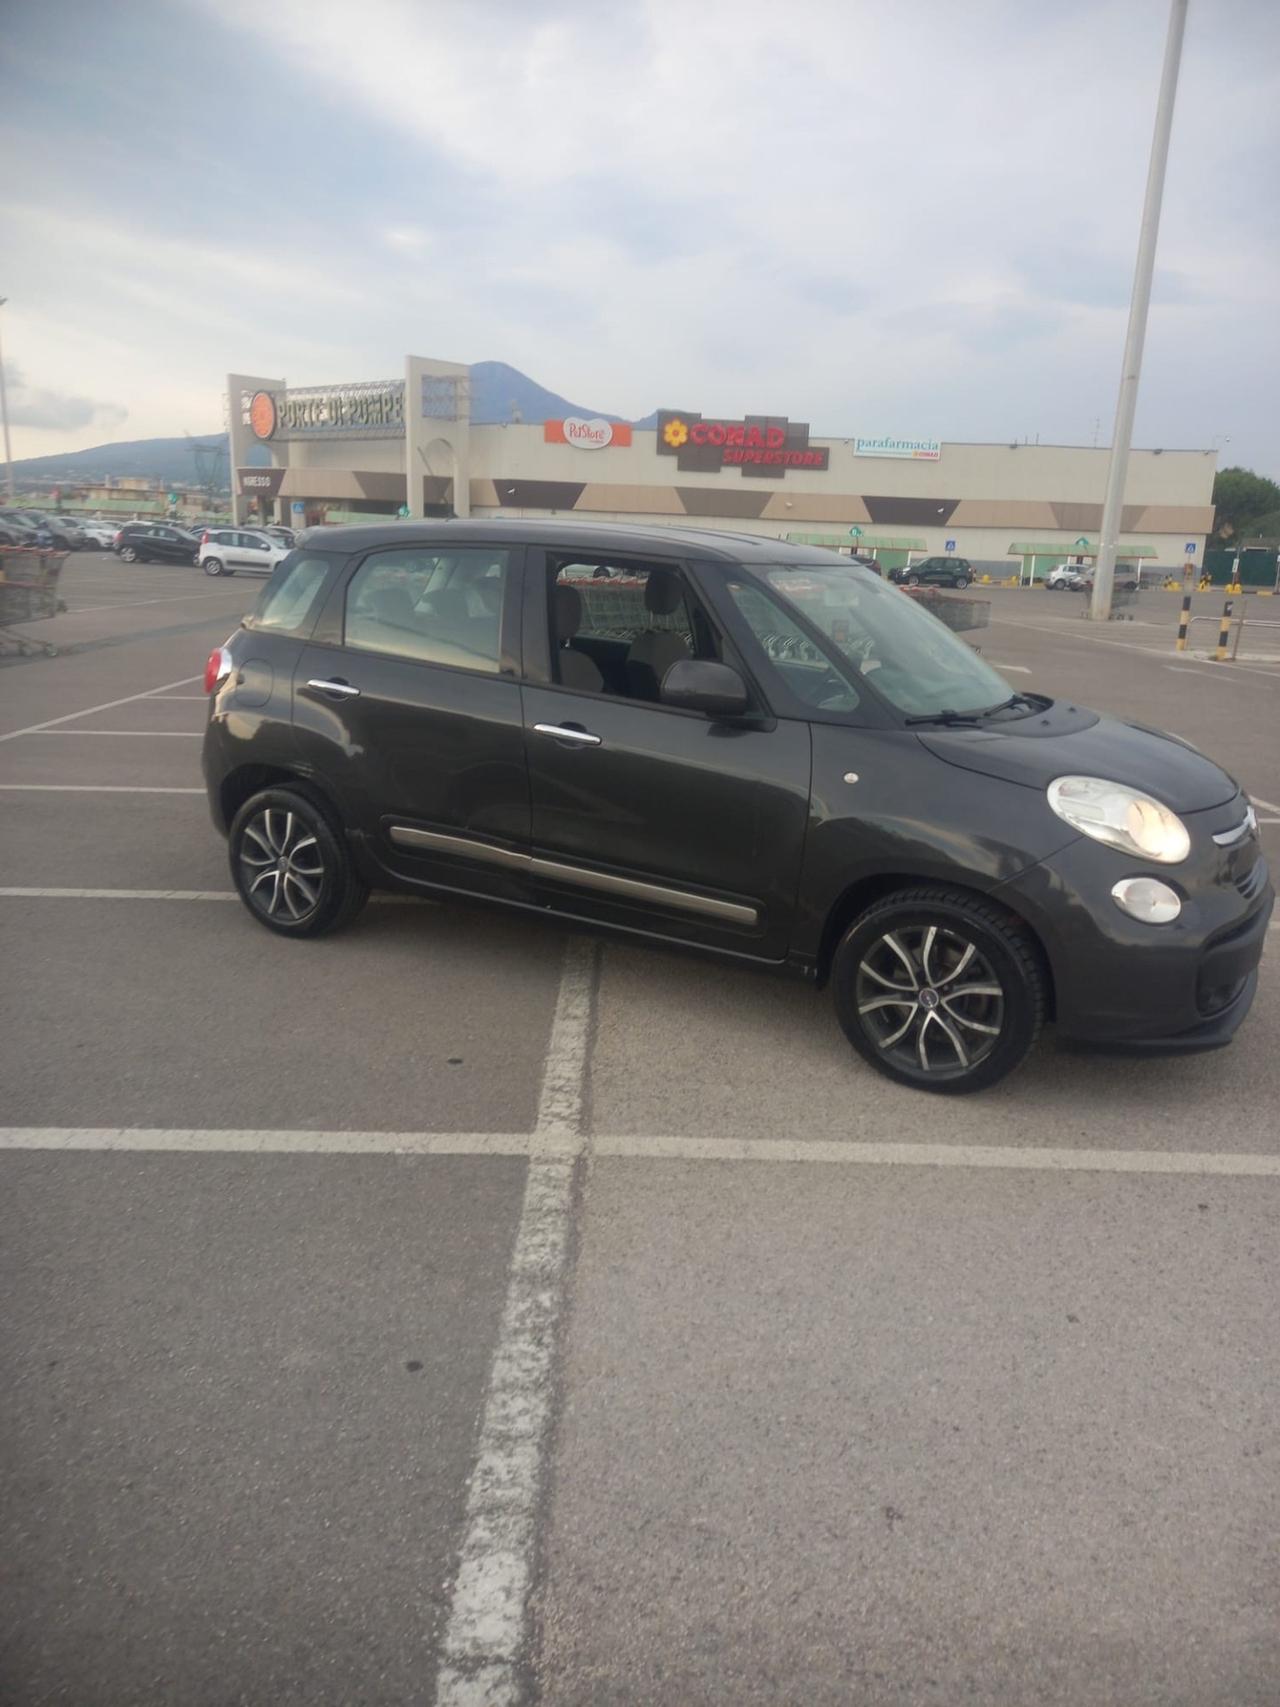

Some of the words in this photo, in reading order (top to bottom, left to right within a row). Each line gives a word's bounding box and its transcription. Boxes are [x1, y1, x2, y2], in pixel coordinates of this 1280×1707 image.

[277, 398, 325, 429] PORTE
[328, 396, 344, 426] DI
[690, 422, 784, 449] CONAD
[857, 437, 939, 451] parafarmacia
[723, 449, 823, 465] SUPERSTORE
